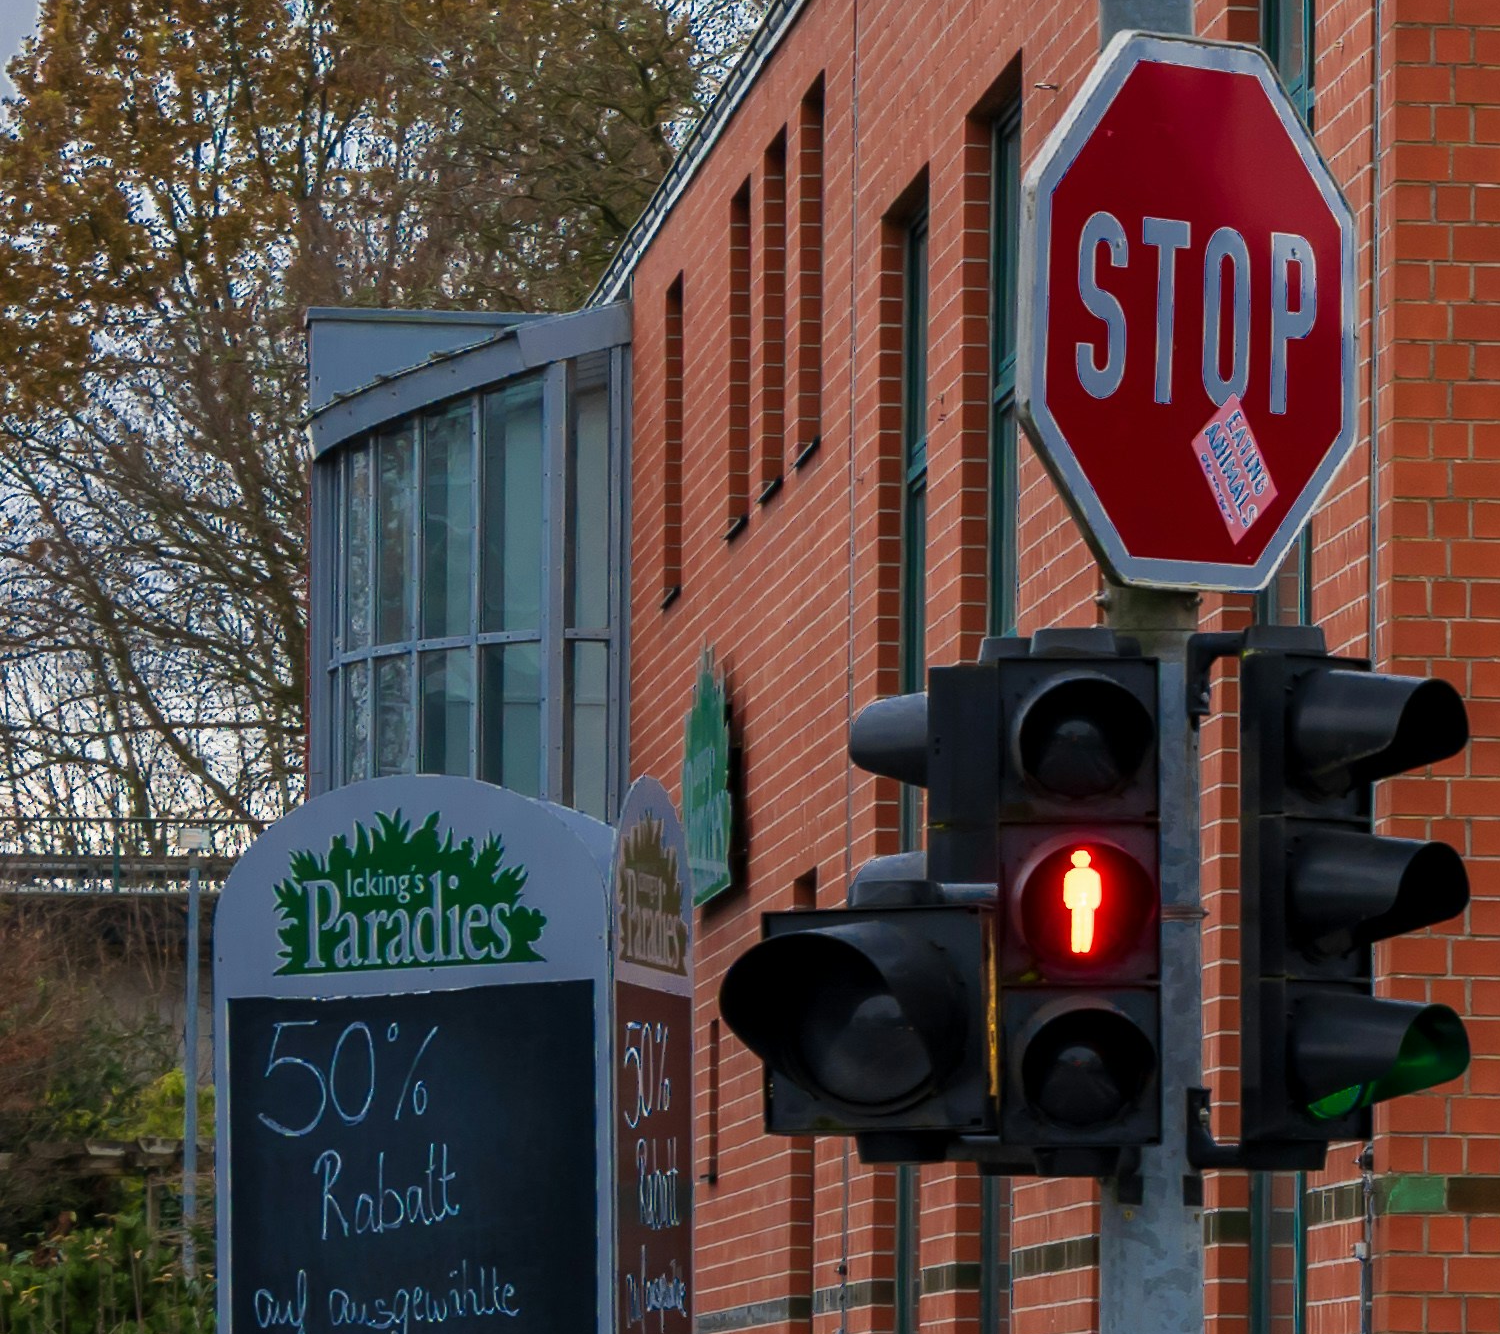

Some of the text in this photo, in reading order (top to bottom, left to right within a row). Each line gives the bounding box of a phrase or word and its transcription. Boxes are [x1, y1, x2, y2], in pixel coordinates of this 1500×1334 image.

[1075, 210, 1318, 415] STOP
[1203, 421, 1258, 528] ANIMALS
[1225, 410, 1269, 496] EATING
[302, 869, 512, 968] Paradies
[258, 1019, 439, 1137] 50%
[313, 1142, 460, 1241] Rabatt
